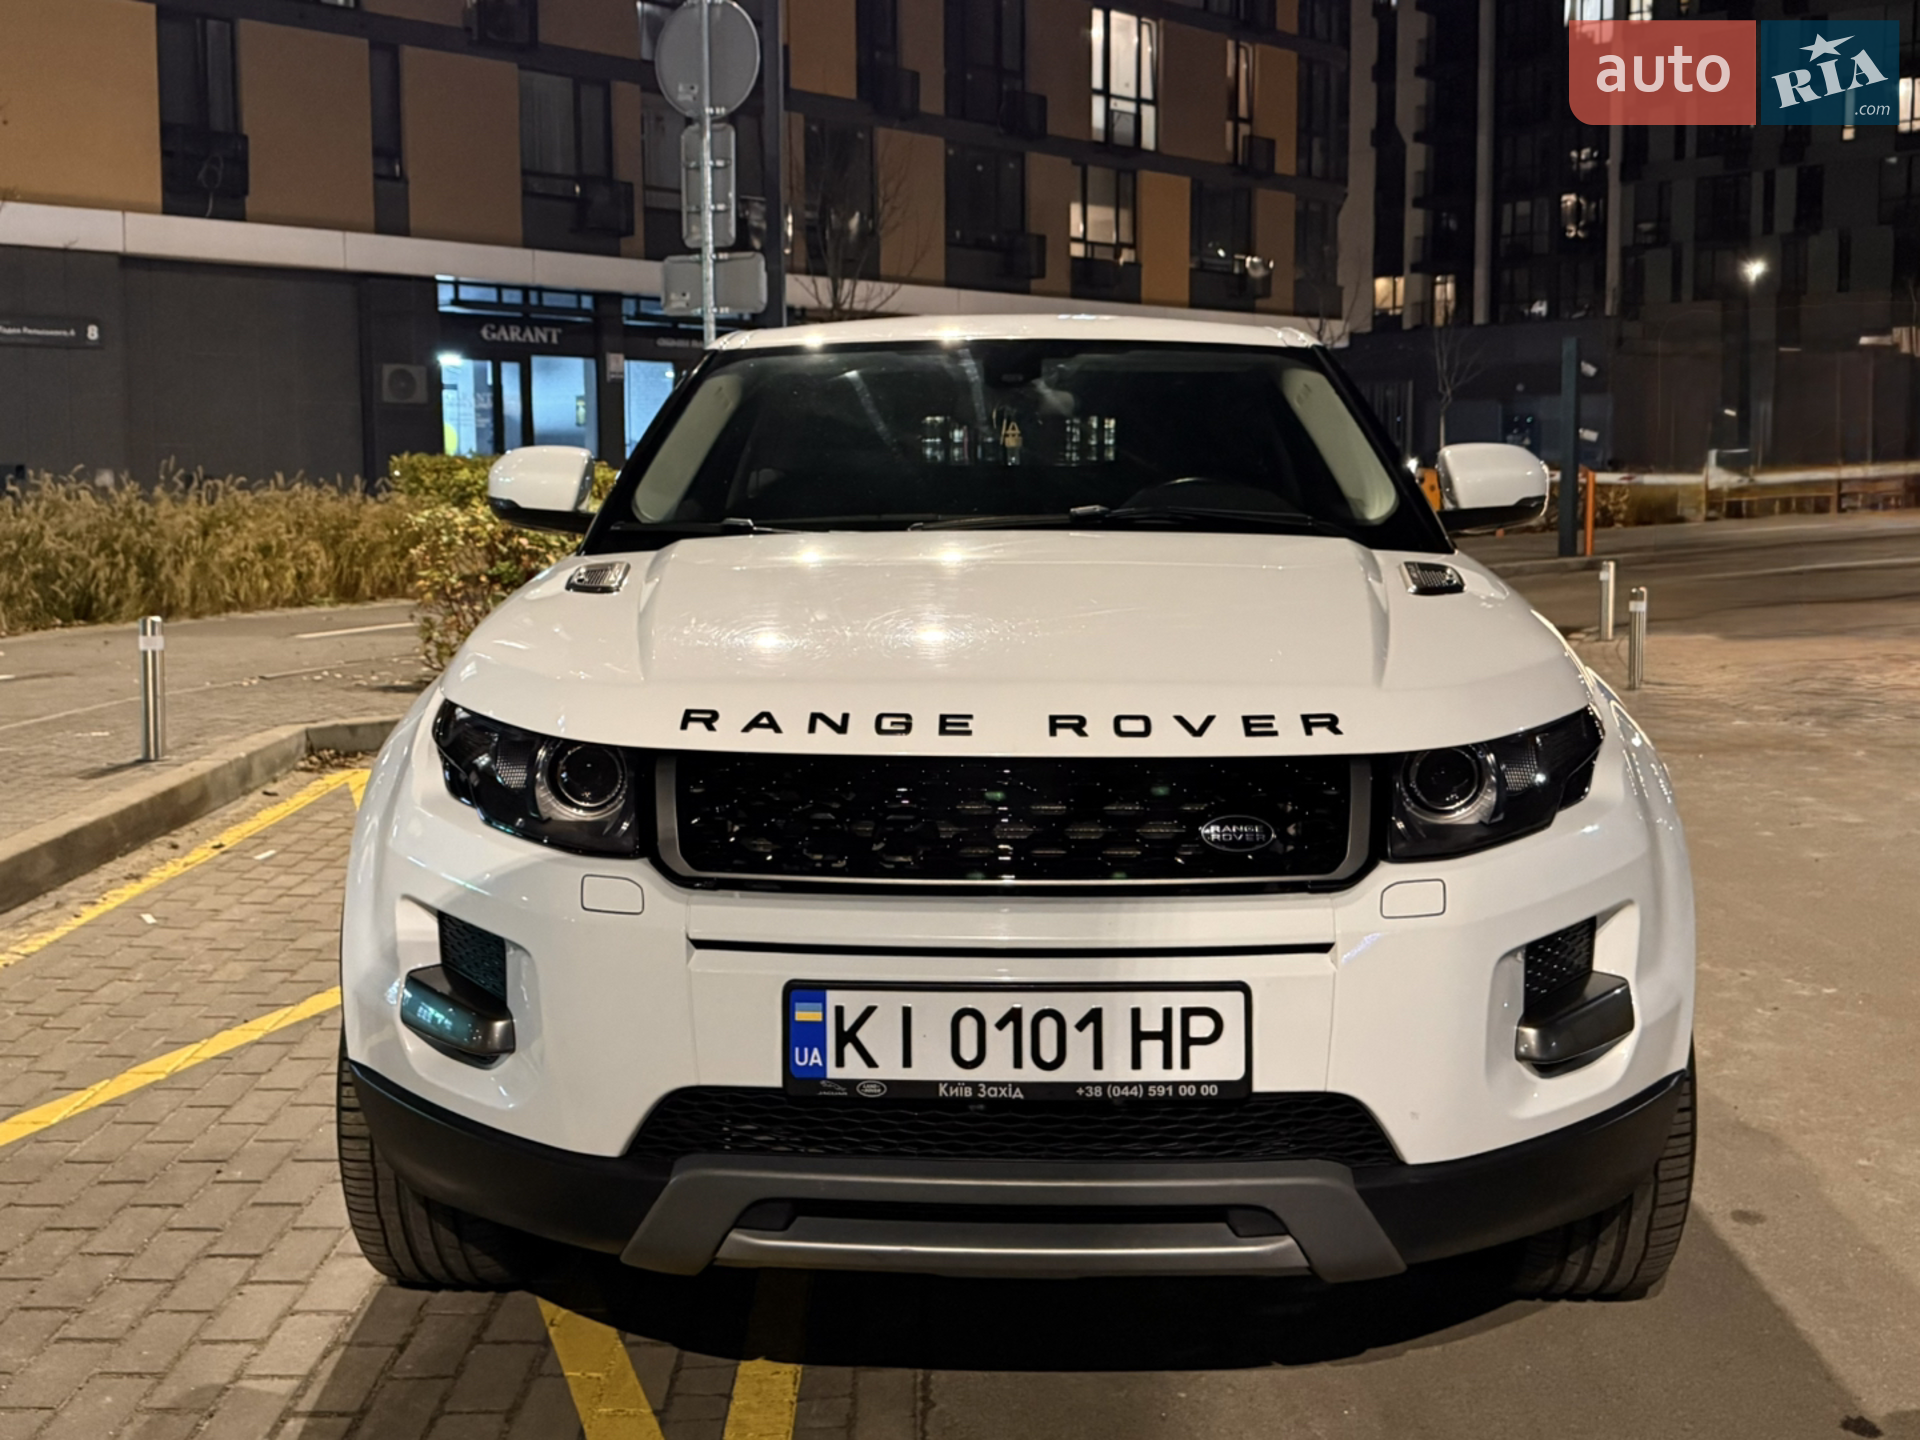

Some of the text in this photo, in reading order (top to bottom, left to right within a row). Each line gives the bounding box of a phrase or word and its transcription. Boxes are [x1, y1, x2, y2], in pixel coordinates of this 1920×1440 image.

[86, 324, 99, 340] 8
[480, 323, 562, 344] GARANT
[680, 708, 1344, 738] RANGE ROVER
[1210, 833, 1266, 841] ROVER
[950, 1005, 1104, 1071] 0101
[1131, 1007, 1224, 1070] HP
[794, 1047, 823, 1067] UA
[938, 1082, 1024, 1099] Київ Захід
[1076, 1084, 1218, 1098] +38 (044) 591 00 00
